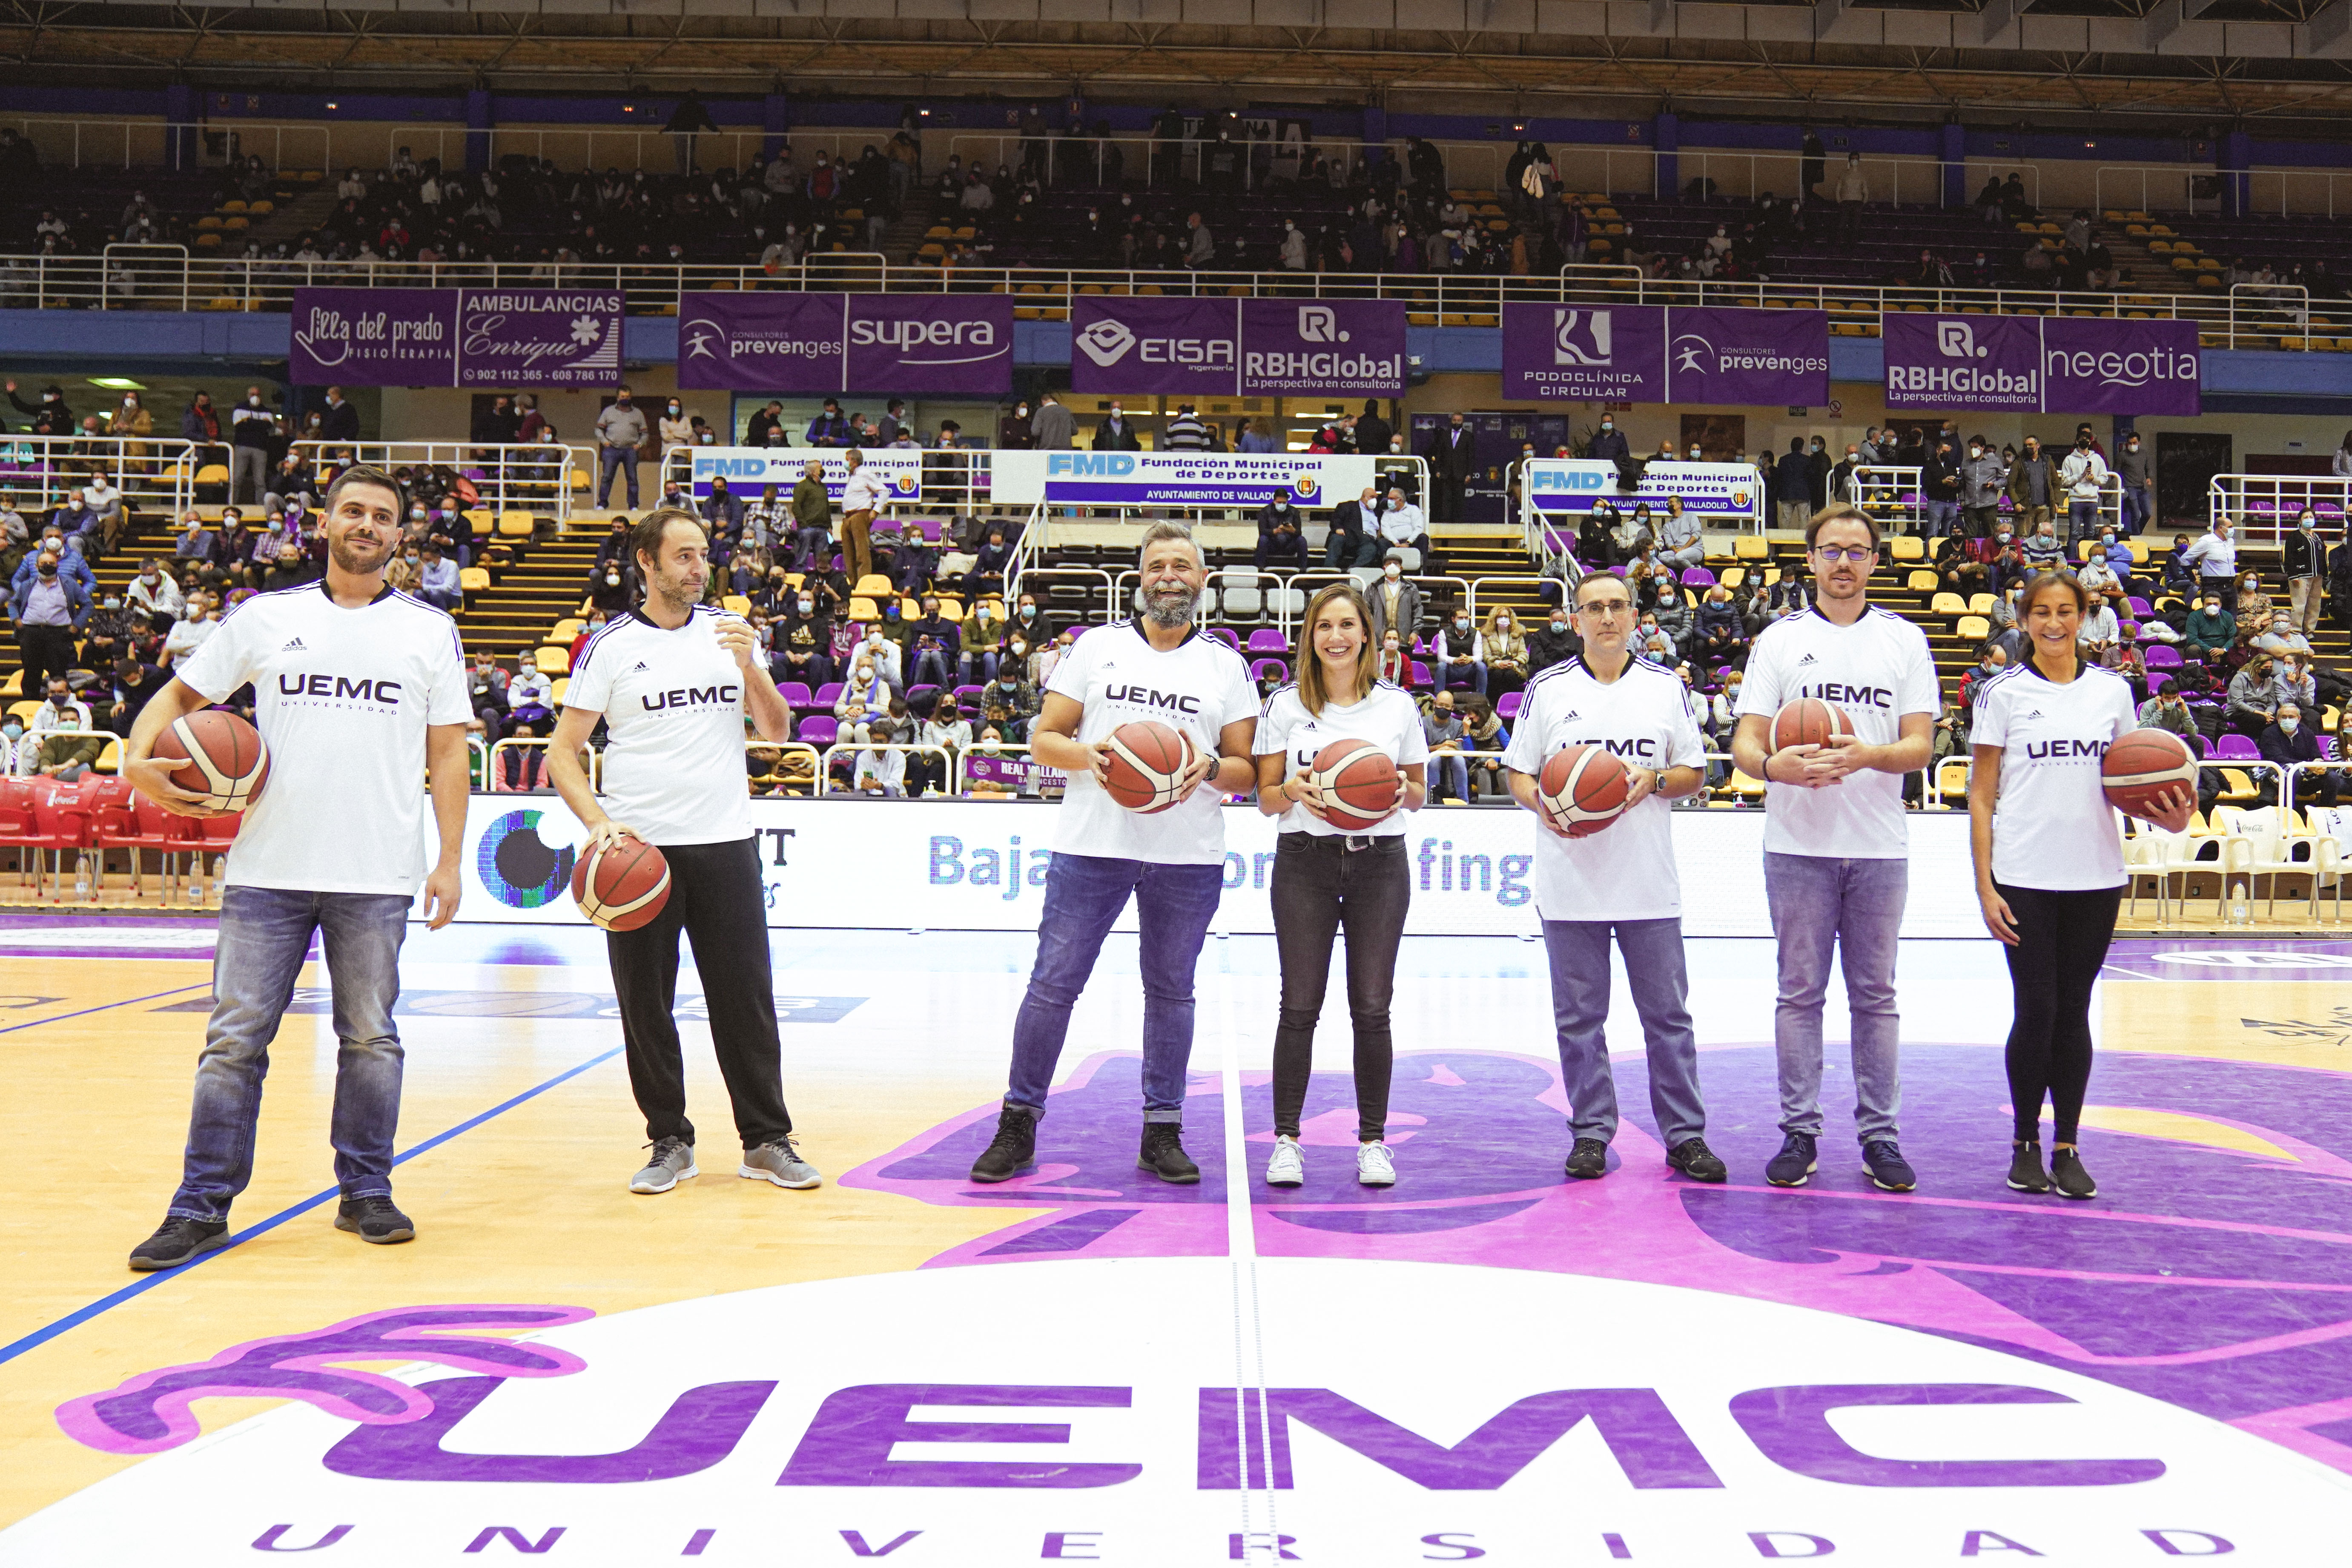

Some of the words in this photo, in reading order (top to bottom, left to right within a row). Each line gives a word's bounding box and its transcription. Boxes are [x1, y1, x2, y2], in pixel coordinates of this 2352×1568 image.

[467, 295, 620, 312] AMBULANCIAS
[356, 312, 386, 340] del
[393, 312, 442, 358] prado
[464, 313, 577, 367] Enrique
[852, 320, 994, 352] supera
[731, 338, 842, 358] prevenges
[1140, 339, 1234, 364] EISA
[1246, 353, 1400, 378] RBHGlobal
[1720, 354, 1827, 375] prevenges
[477, 370, 497, 380] 902
[501, 370, 519, 380] 112
[522, 370, 542, 380] 365
[553, 370, 572, 380] 608
[599, 370, 617, 380] 170
[1246, 378, 1258, 387] La
[1261, 378, 1323, 389] perspectiva
[1325, 380, 1338, 388] en
[1340, 378, 1400, 389] consultoría
[1524, 370, 1643, 383] PODOCLÍNICA
[1889, 366, 2036, 393] RBHGlobal
[1540, 387, 1627, 397] CIRCULAR
[1889, 390, 1900, 400] La
[1903, 392, 1962, 403] perspectiva
[1965, 394, 1977, 402] en
[1980, 393, 2036, 404] consultoría
[695, 459, 766, 476] FMD
[1048, 454, 1135, 477] FMD
[1142, 459, 1229, 468] Fundación
[1235, 460, 1321, 470] Municipal
[1176, 470, 1196, 478] de
[1202, 470, 1290, 480] Deportes
[1533, 471, 1603, 490] FMD
[1682, 474, 1752, 483] Municipal
[1147, 490, 1220, 500] AYUNTAMIENTO
[1222, 491, 1234, 500] DE
[1656, 484, 1728, 493] Deportes
[1684, 501, 1728, 509] VALLADOLID
[279, 674, 402, 704] UEMC
[642, 685, 737, 711] UEMC
[1802, 683, 1892, 708] UEMC
[281, 701, 397, 715] UNIVERSIDAD
[1106, 684, 1200, 714] UEMC
[648, 707, 735, 720] UNIVERSIDAD
[1107, 705, 1195, 723] UNIVERSIDAD
[1001, 761, 1025, 776] REAL
[322, 1375, 2166, 1490] UEMC
[251, 1523, 2235, 1563] UNIVERSIDAD
